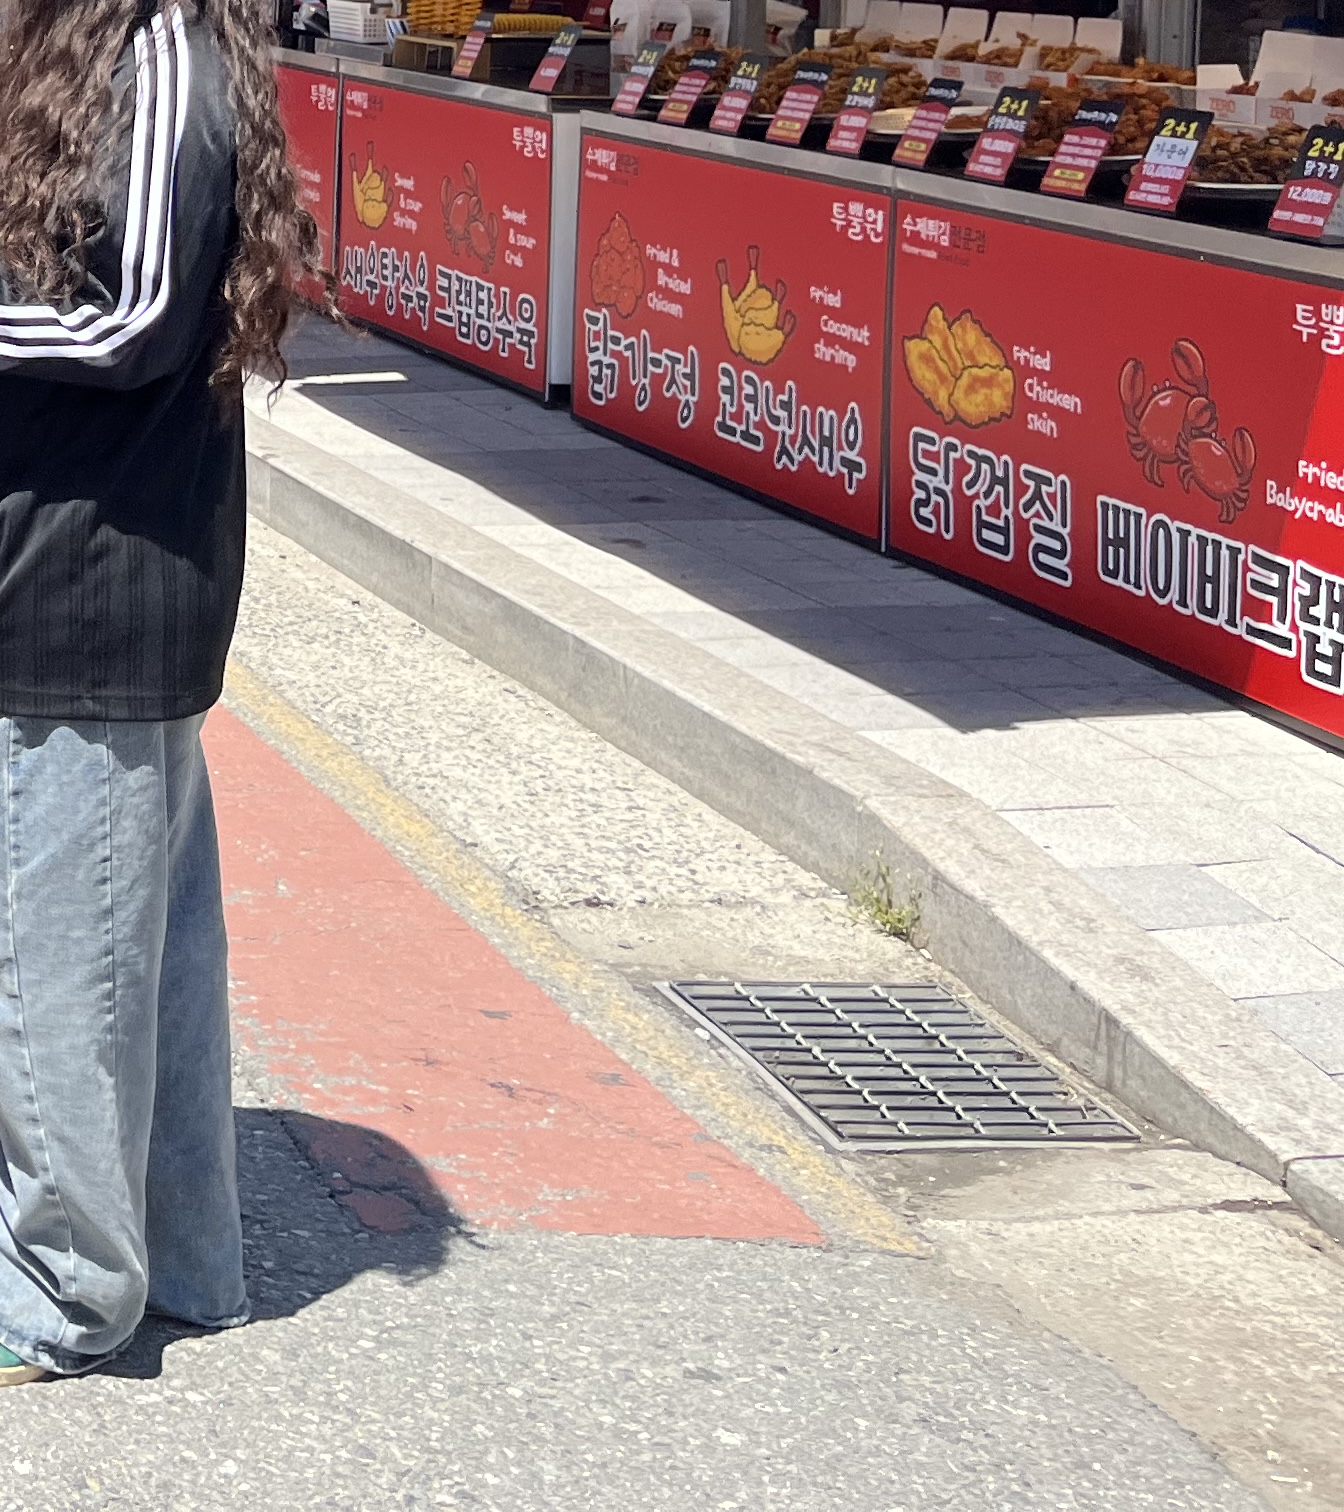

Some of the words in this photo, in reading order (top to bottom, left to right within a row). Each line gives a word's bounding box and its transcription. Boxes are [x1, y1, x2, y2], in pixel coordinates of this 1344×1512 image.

[997, 95, 1029, 117] 2+1
[1160, 117, 1199, 139] 2+1
[830, 200, 885, 244] 투뿔원
[342, 240, 430, 331] 새우탕수육
[434, 263, 538, 370] 크랩탕수육
[809, 286, 842, 309] Fried
[820, 314, 872, 347] Coconut
[1013, 344, 1052, 373] Fried
[583, 307, 699, 429] 닭강정
[714, 361, 867, 495] 코코넛새우
[1024, 377, 1082, 416] Chicken
[1027, 413, 1059, 439] skin
[909, 426, 1073, 588] 닭껍질
[1096, 494, 1344, 695] 베이비크랩
